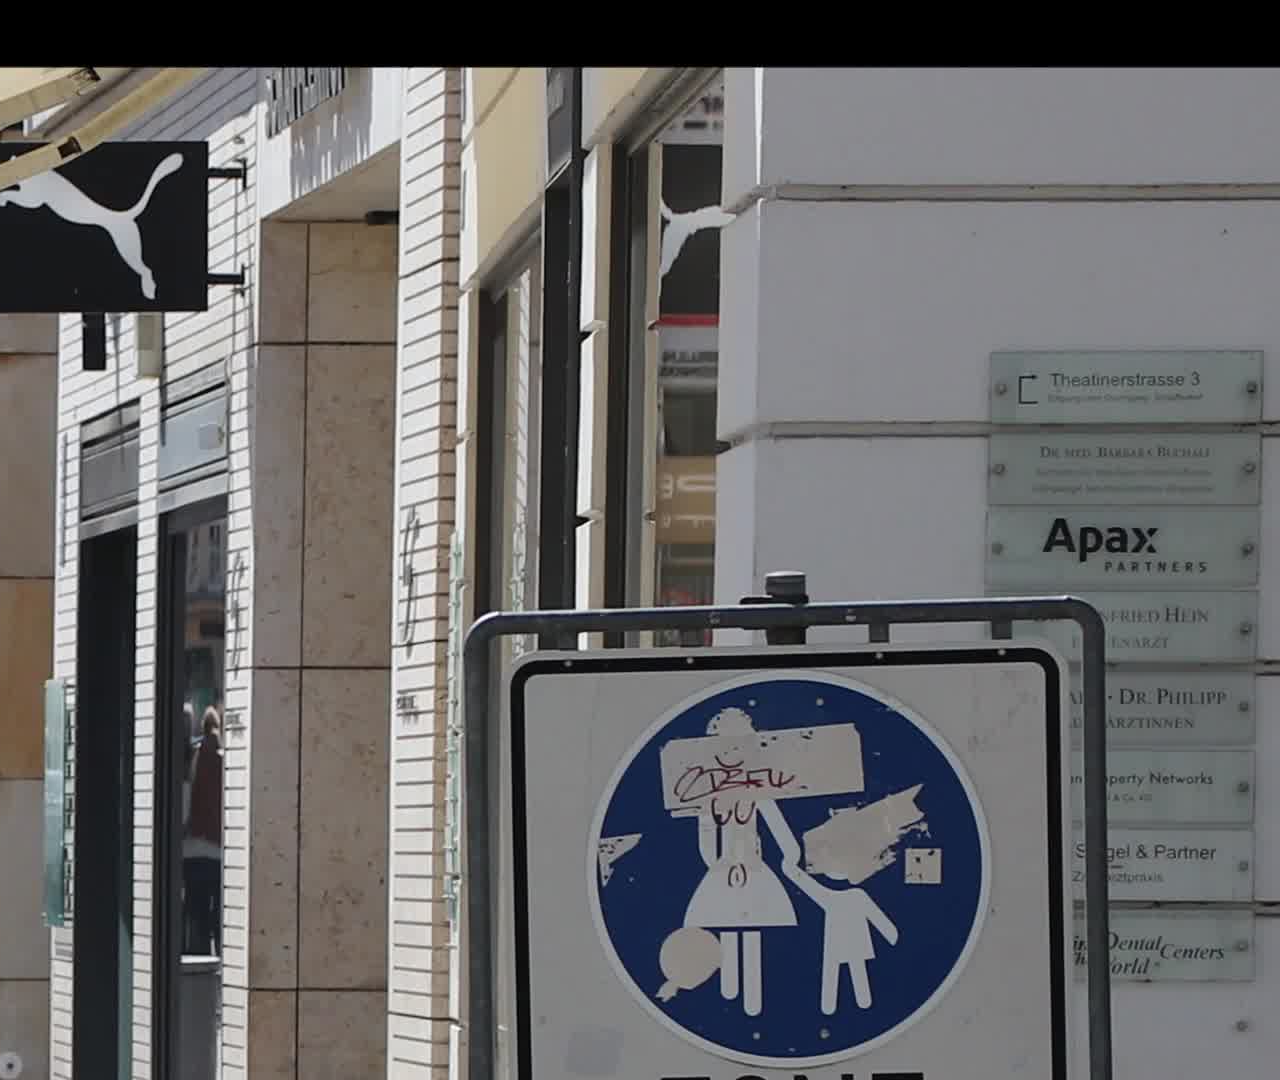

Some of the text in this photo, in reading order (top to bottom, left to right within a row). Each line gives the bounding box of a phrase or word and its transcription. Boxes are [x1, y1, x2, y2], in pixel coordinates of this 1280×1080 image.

[1048, 371, 1201, 387] Theatinerstrasse 3
[1042, 517, 1159, 562] Apax
[1105, 561, 1208, 573] PARTNERS
[1164, 606, 1209, 624] HEIN
[1156, 687, 1227, 705] PHILIPP
[1149, 771, 1214, 785] Networks
[1135, 843, 1148, 860] &
[1154, 843, 1217, 860] Partner
[1108, 931, 1162, 952] Dental
[1160, 943, 1226, 961] Centers
[1110, 957, 1151, 975] orld
